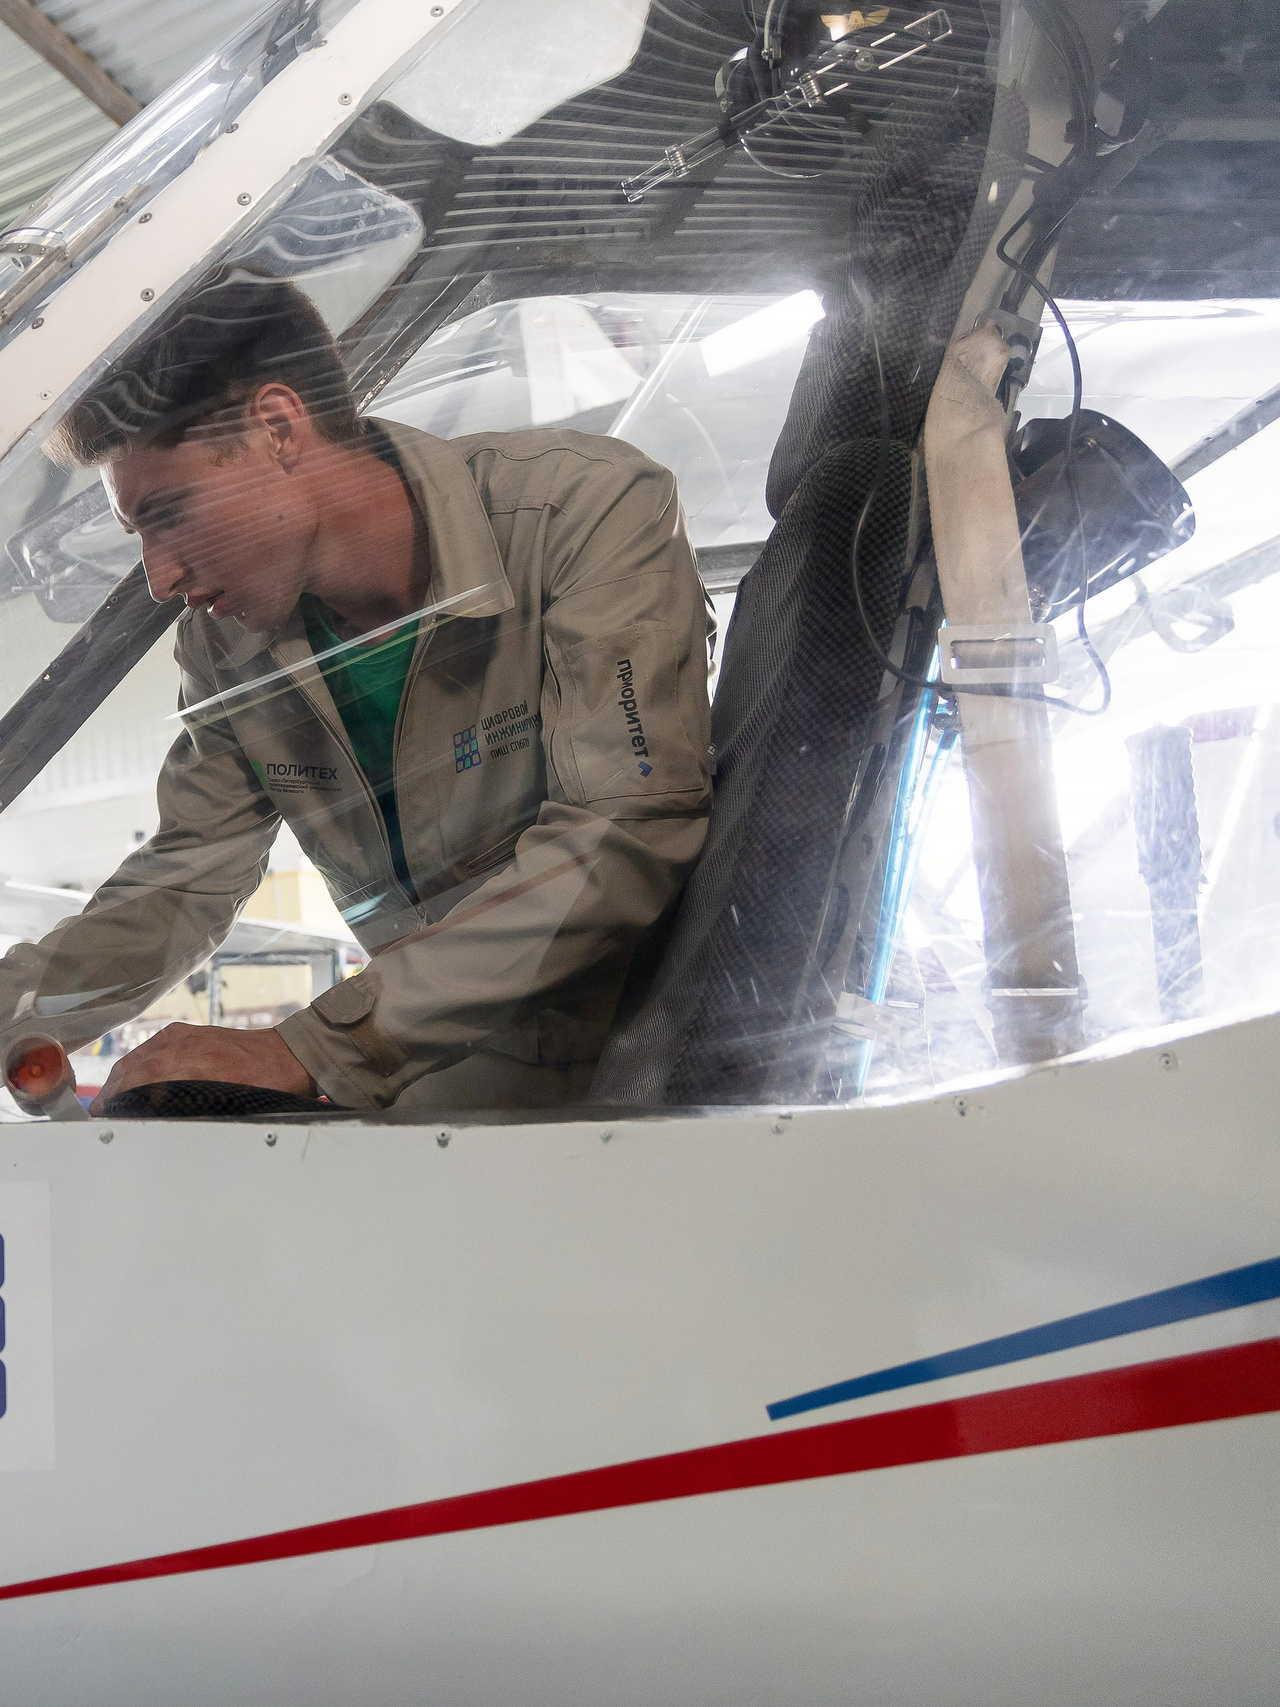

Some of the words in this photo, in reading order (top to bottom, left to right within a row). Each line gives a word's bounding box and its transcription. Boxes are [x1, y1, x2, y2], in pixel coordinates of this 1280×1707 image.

[481, 700, 528, 731] ЦИФРОВОЙ
[617, 659, 649, 757] приоритет
[490, 745, 509, 759] ПИШ
[266, 763, 338, 780] ПОЛИТЕХ
